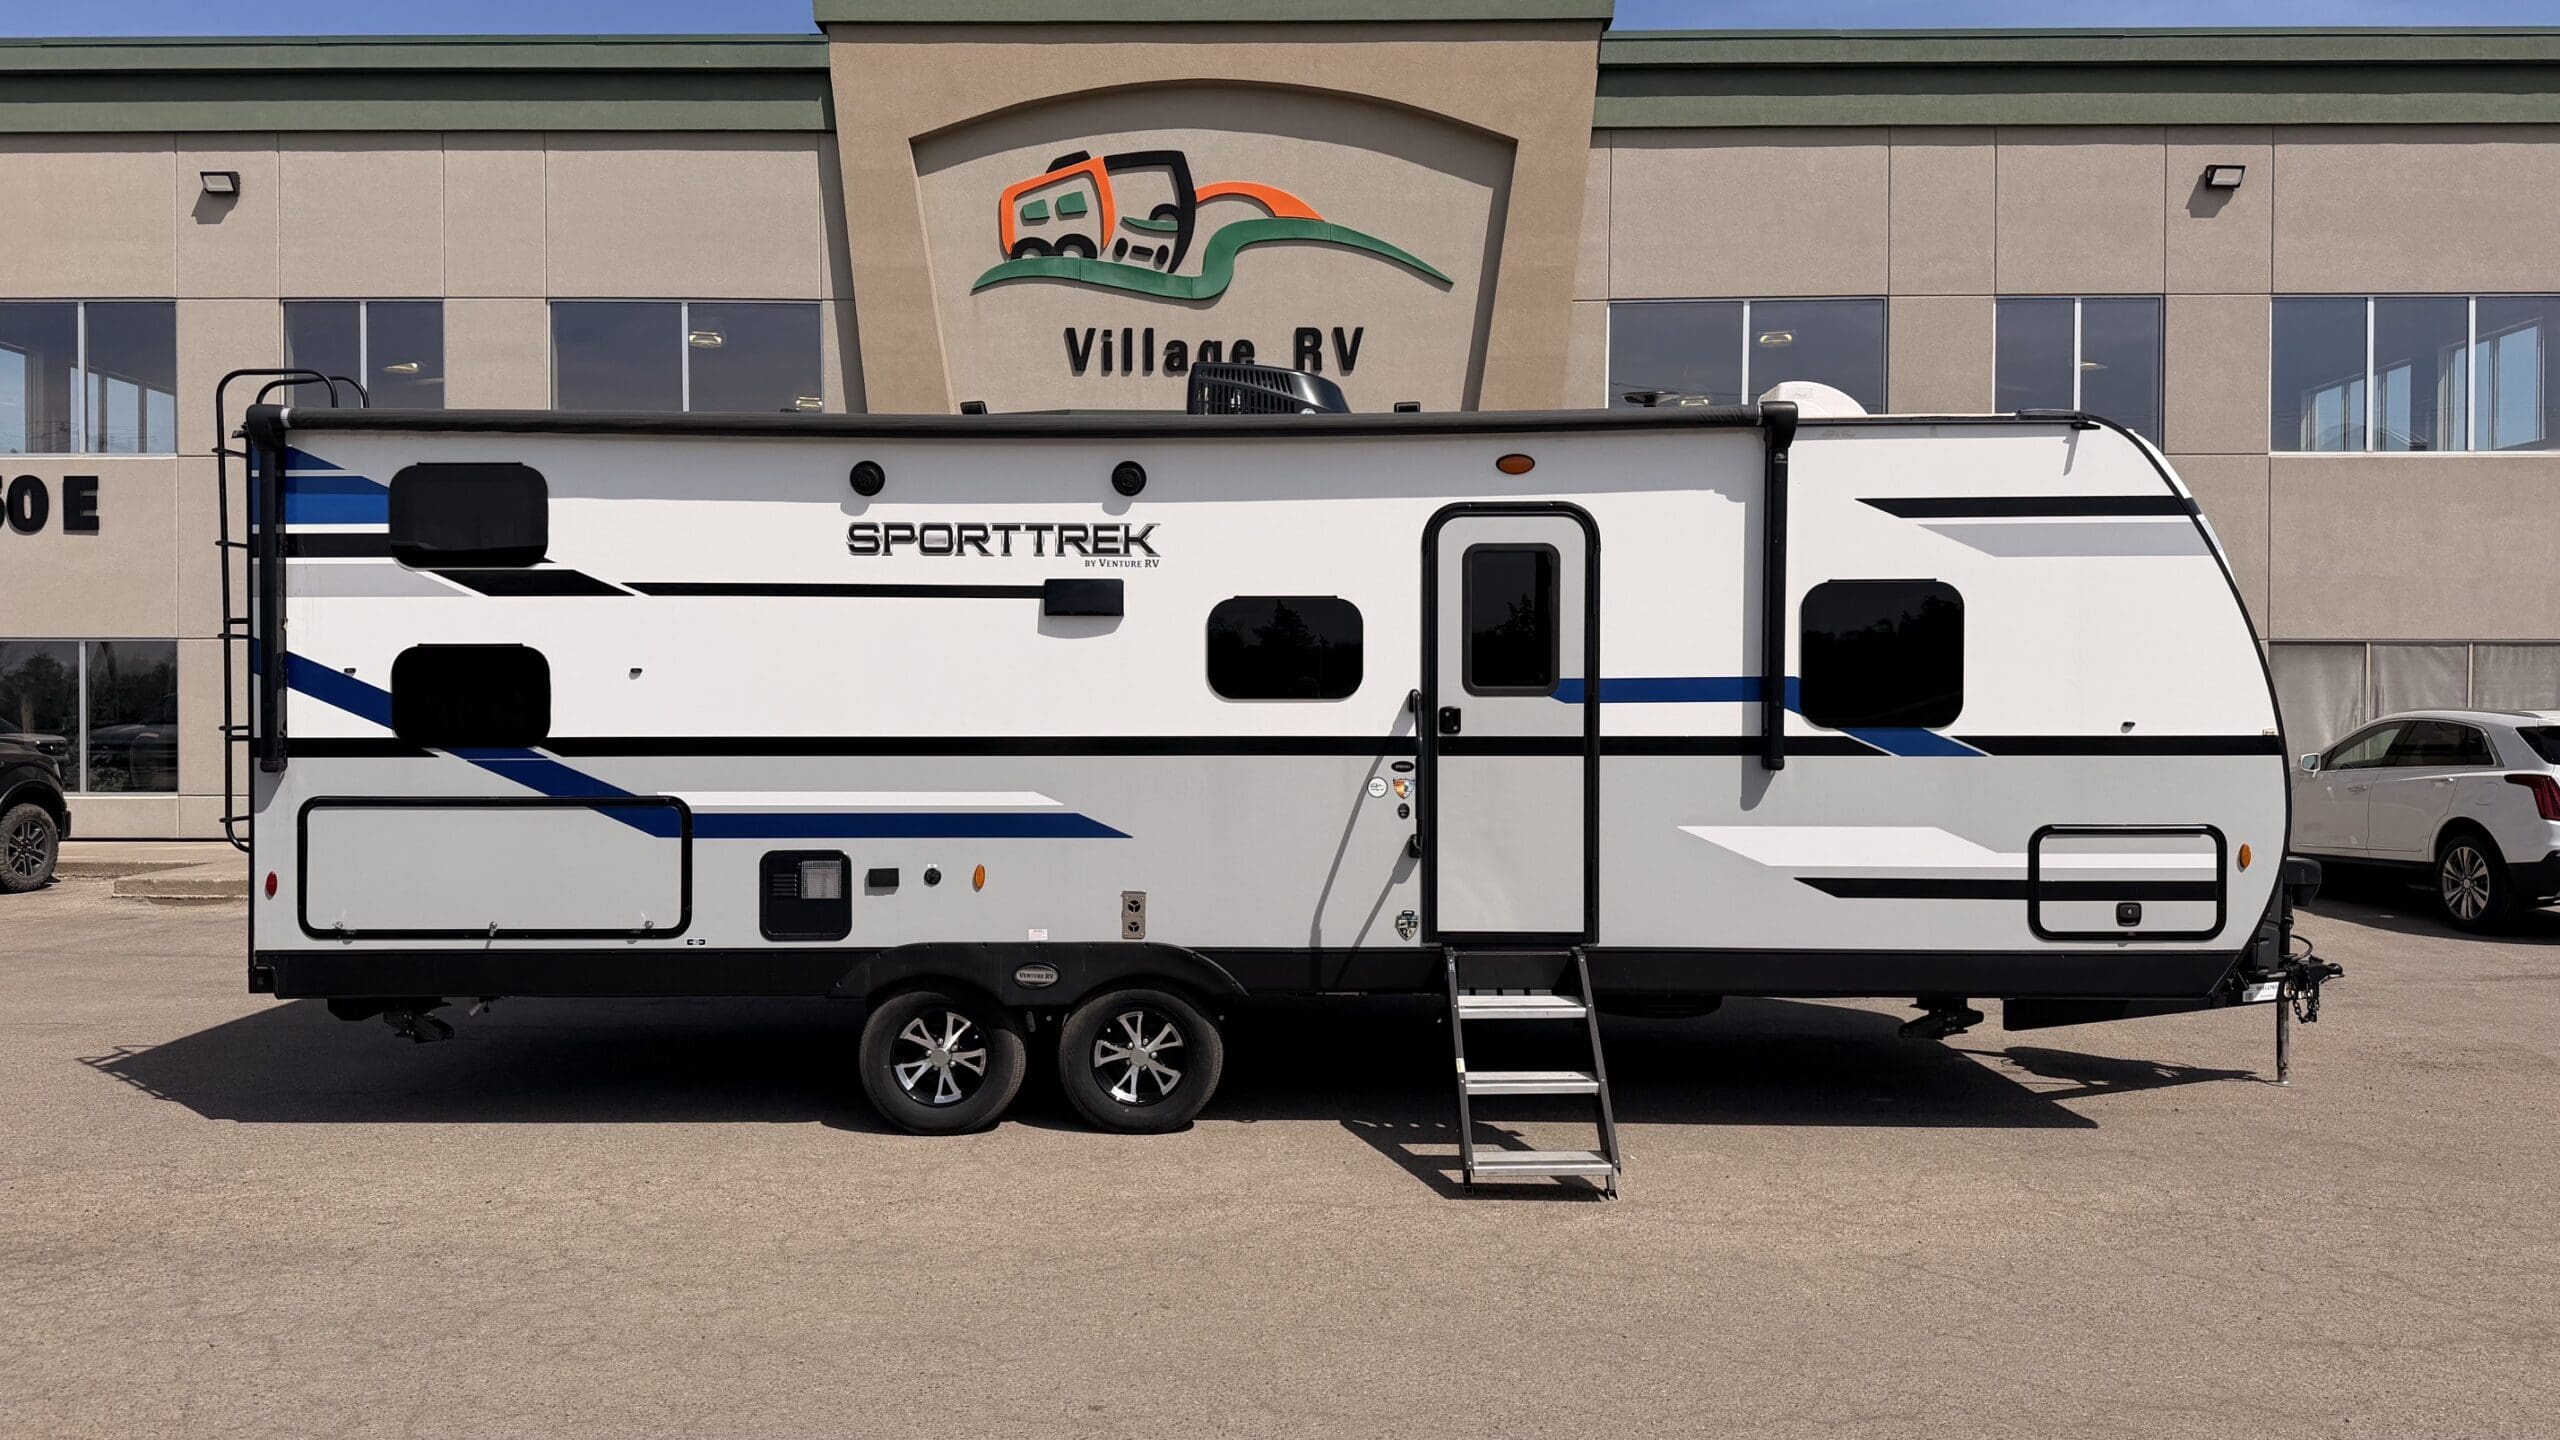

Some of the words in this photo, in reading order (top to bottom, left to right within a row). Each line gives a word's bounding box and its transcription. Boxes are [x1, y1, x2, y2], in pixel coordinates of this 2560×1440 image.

[1294, 327, 1364, 374] RV
[0, 474, 49, 535] 0
[63, 475, 99, 535] E
[846, 522, 1161, 557] SPORTTREK
[1145, 559, 1160, 568] RV
